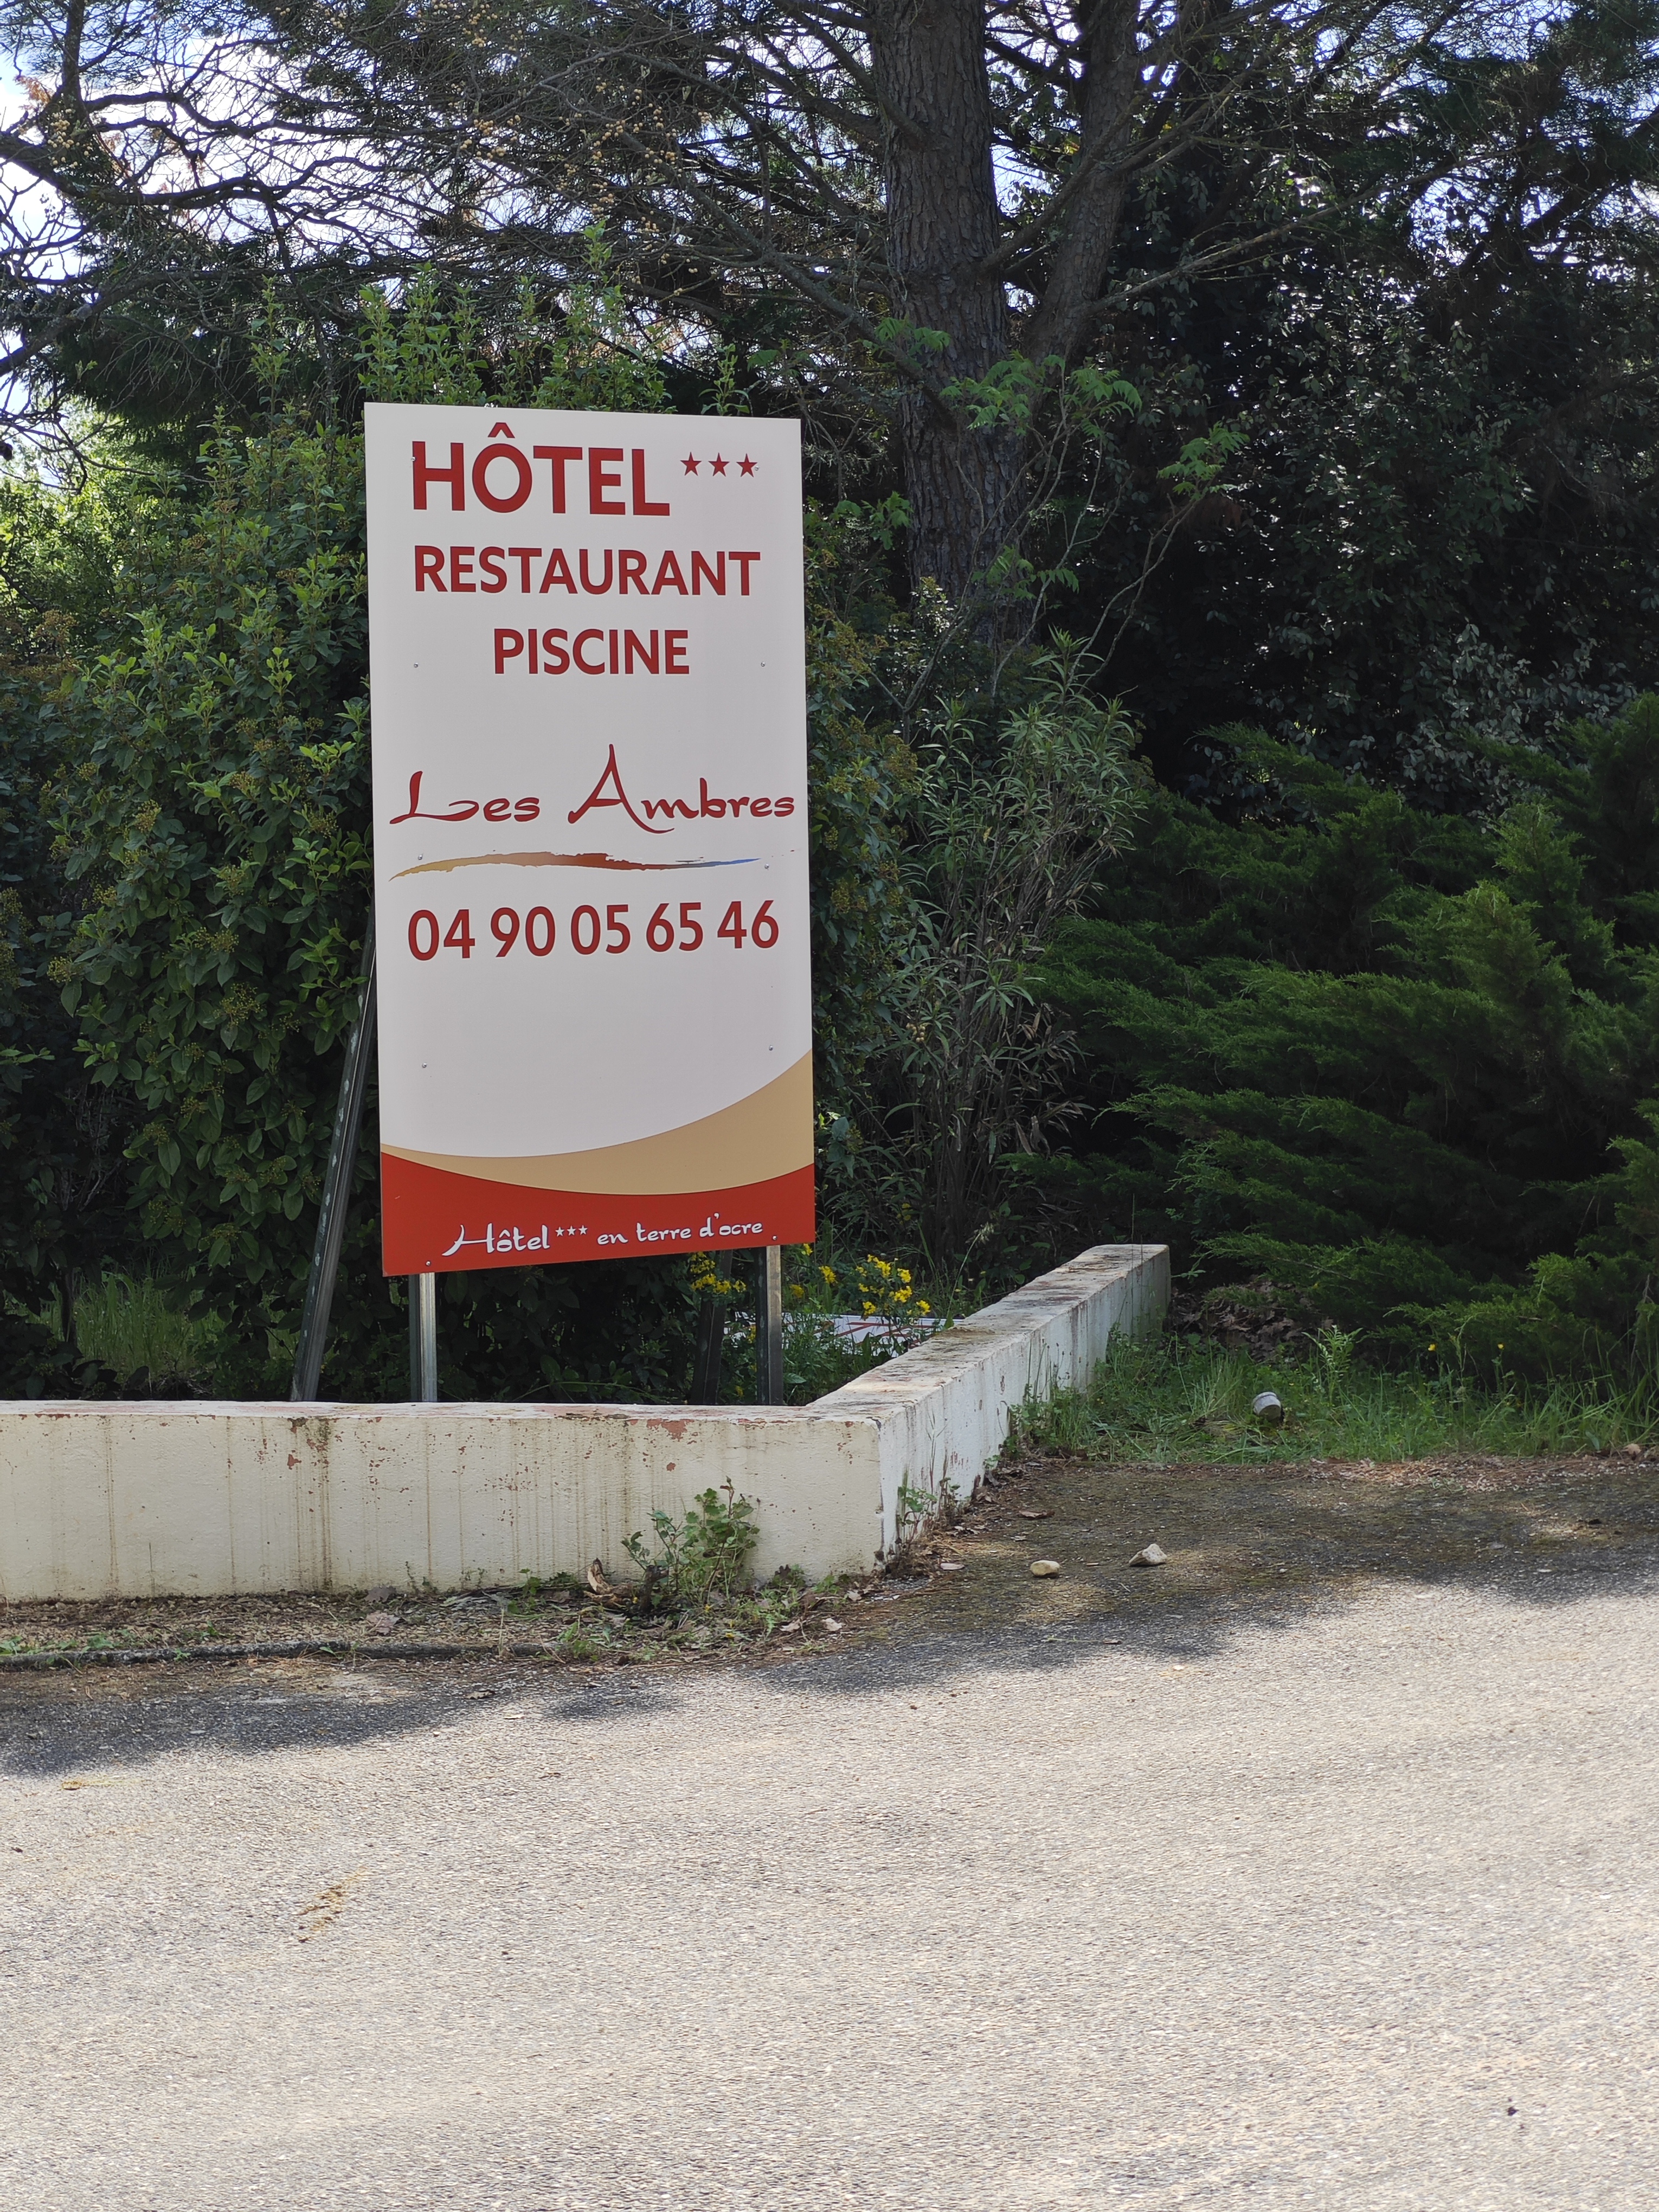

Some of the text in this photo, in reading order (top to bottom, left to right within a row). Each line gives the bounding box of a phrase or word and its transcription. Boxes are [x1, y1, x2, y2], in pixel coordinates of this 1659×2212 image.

[412, 422, 671, 516] HÔTEL
[415, 545, 761, 596] RESTAURANT
[494, 628, 690, 674] PISCINE
[389, 744, 795, 834] Les Ambres
[408, 900, 780, 960] 04 90 05 65 46
[442, 1212, 763, 1256] Hôtel en terre d'ocre
